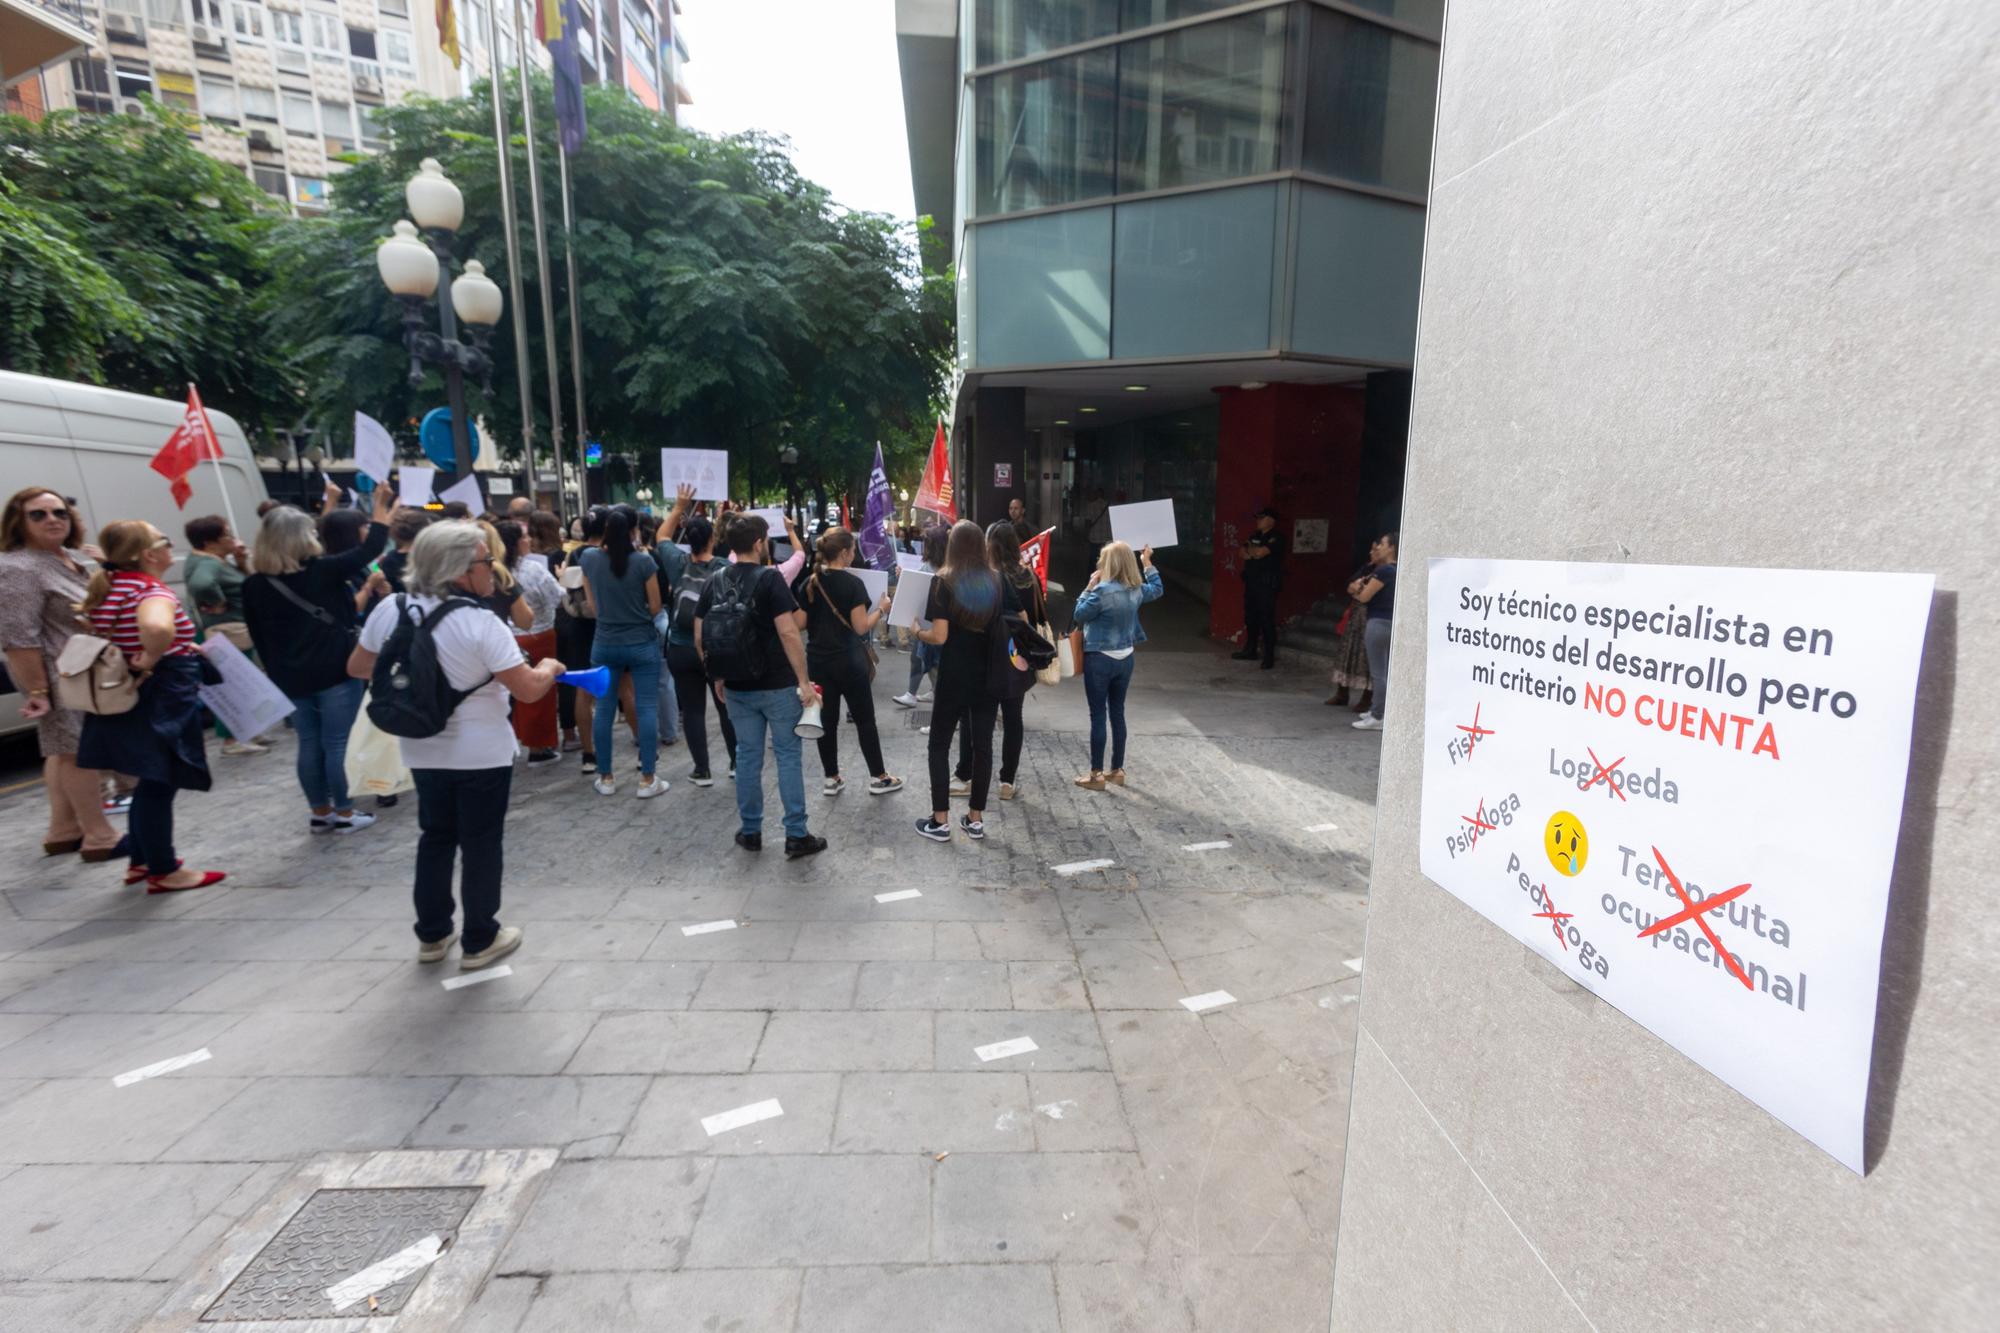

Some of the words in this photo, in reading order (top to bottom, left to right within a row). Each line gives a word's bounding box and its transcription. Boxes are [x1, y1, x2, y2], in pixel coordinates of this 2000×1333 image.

[1447, 622, 1545, 658] trastornos
[1553, 635, 1589, 666] del
[1596, 642, 1747, 697] desarrollo
[1758, 678, 1856, 718] pero
[1460, 587, 1493, 620] Soy
[1498, 590, 1576, 623] técnico
[1585, 604, 1769, 647] especialista
[1784, 627, 1832, 656] en
[1473, 662, 1494, 685] mi
[1500, 668, 1576, 705] criterio
[1584, 681, 1626, 717] NO
[1635, 695, 1779, 760] CUENTA
[1550, 749, 1678, 803] Logopeda
[1447, 792, 1520, 858] Psicóloga
[1507, 853, 1609, 979] Pedagoga
[1619, 846, 1789, 948] Terapeuta
[1602, 894, 1805, 1011] ocupacional
